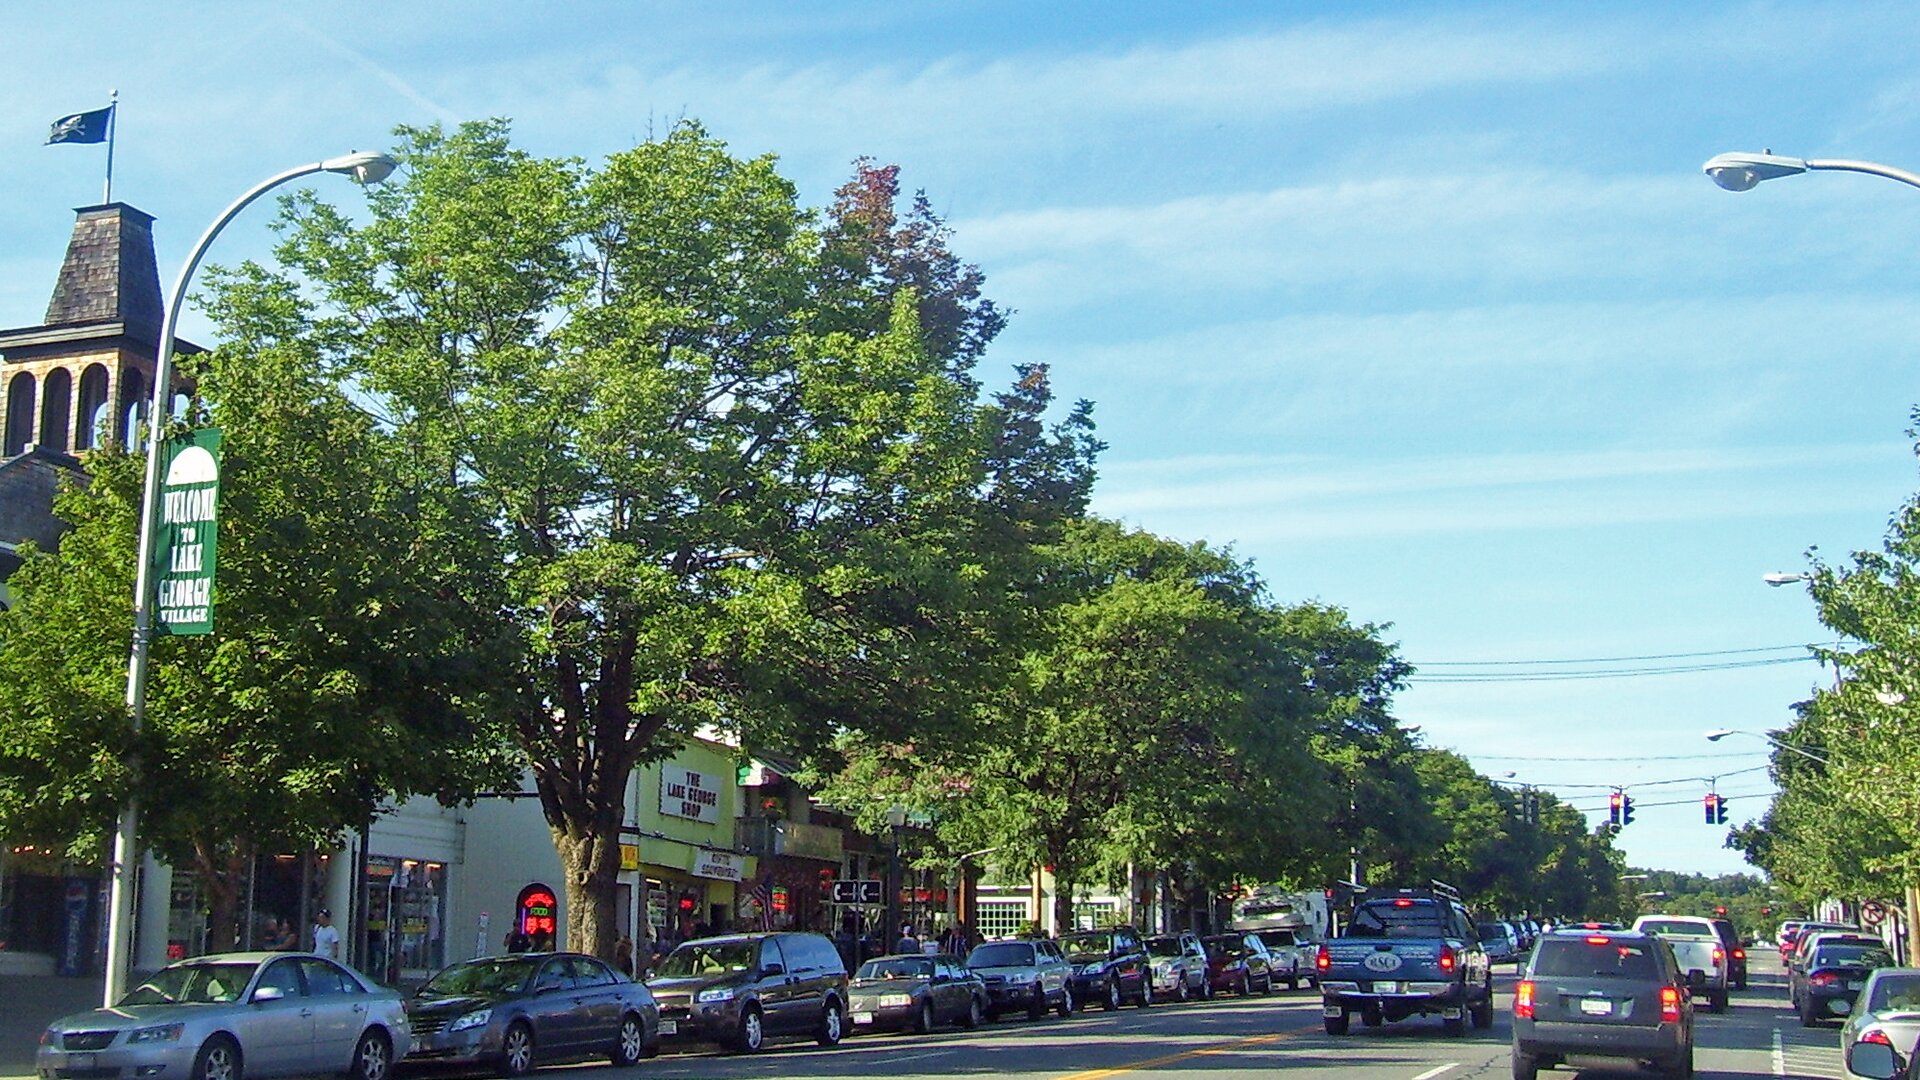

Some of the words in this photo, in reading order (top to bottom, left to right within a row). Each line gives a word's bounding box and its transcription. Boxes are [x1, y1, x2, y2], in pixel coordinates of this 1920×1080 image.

[164, 486, 216, 524] WELCOME
[181, 528, 196, 543] TO
[171, 543, 203, 572] LAKE
[159, 578, 210, 607] GEORGE
[160, 608, 208, 623] VILLAGE
[687, 772, 700, 787] THE
[667, 782, 686, 799] LAKE
[688, 787, 717, 807] GEORGE
[682, 801, 701, 818] SHOP
